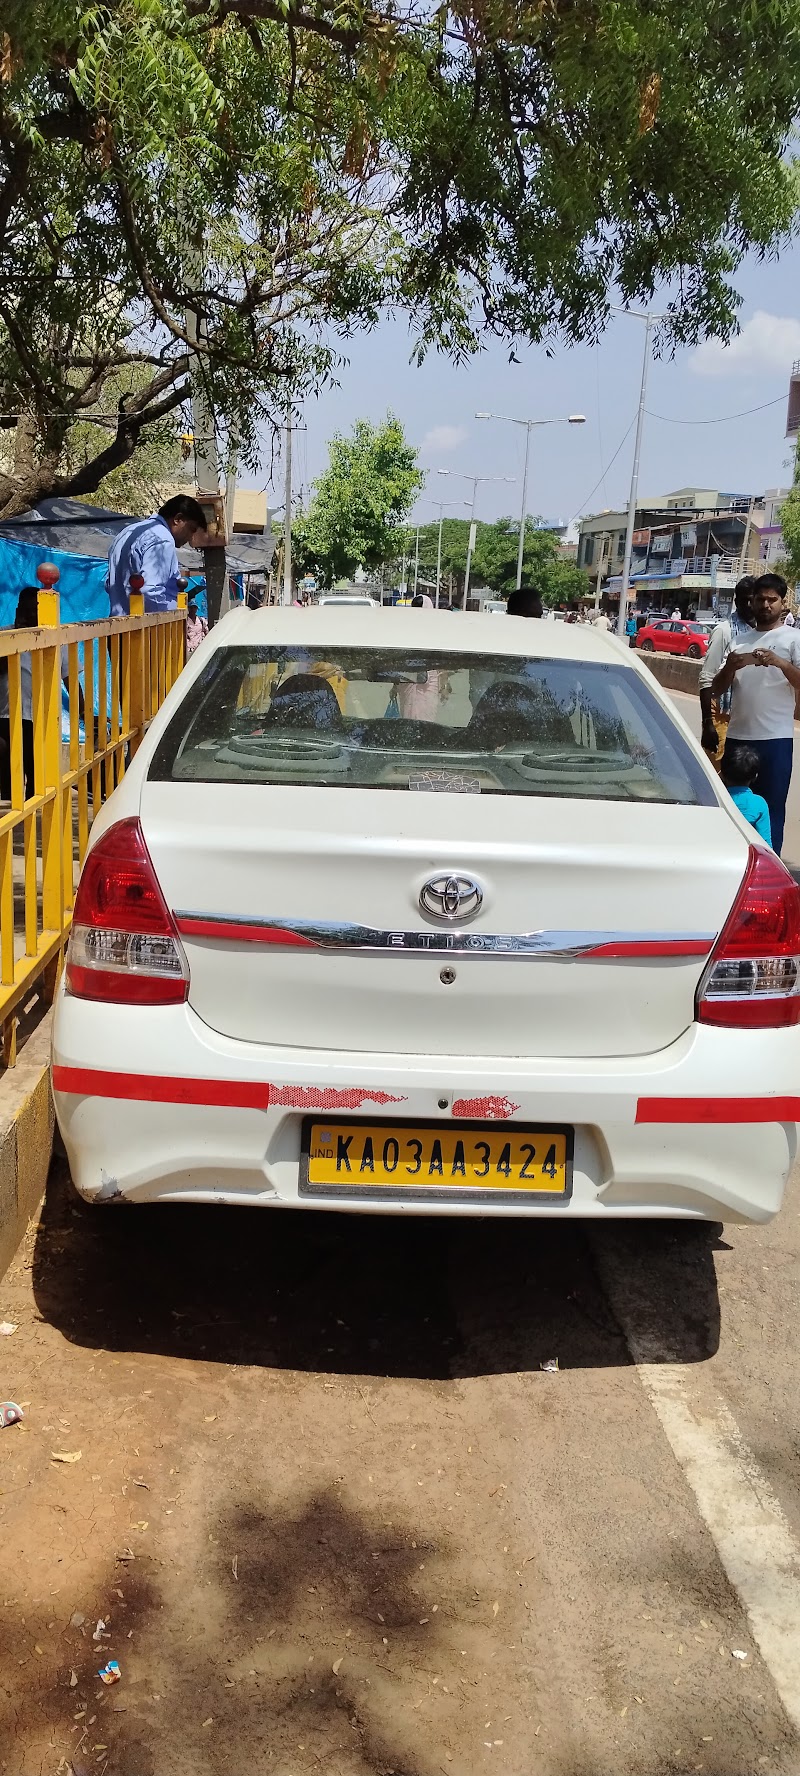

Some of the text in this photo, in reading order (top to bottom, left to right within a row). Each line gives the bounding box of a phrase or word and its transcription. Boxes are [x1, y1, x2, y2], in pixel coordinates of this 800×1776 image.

[386, 932, 515, 949] ETIOS
[314, 1148, 334, 1159] IND
[335, 1134, 558, 1179] KA03AA3424
